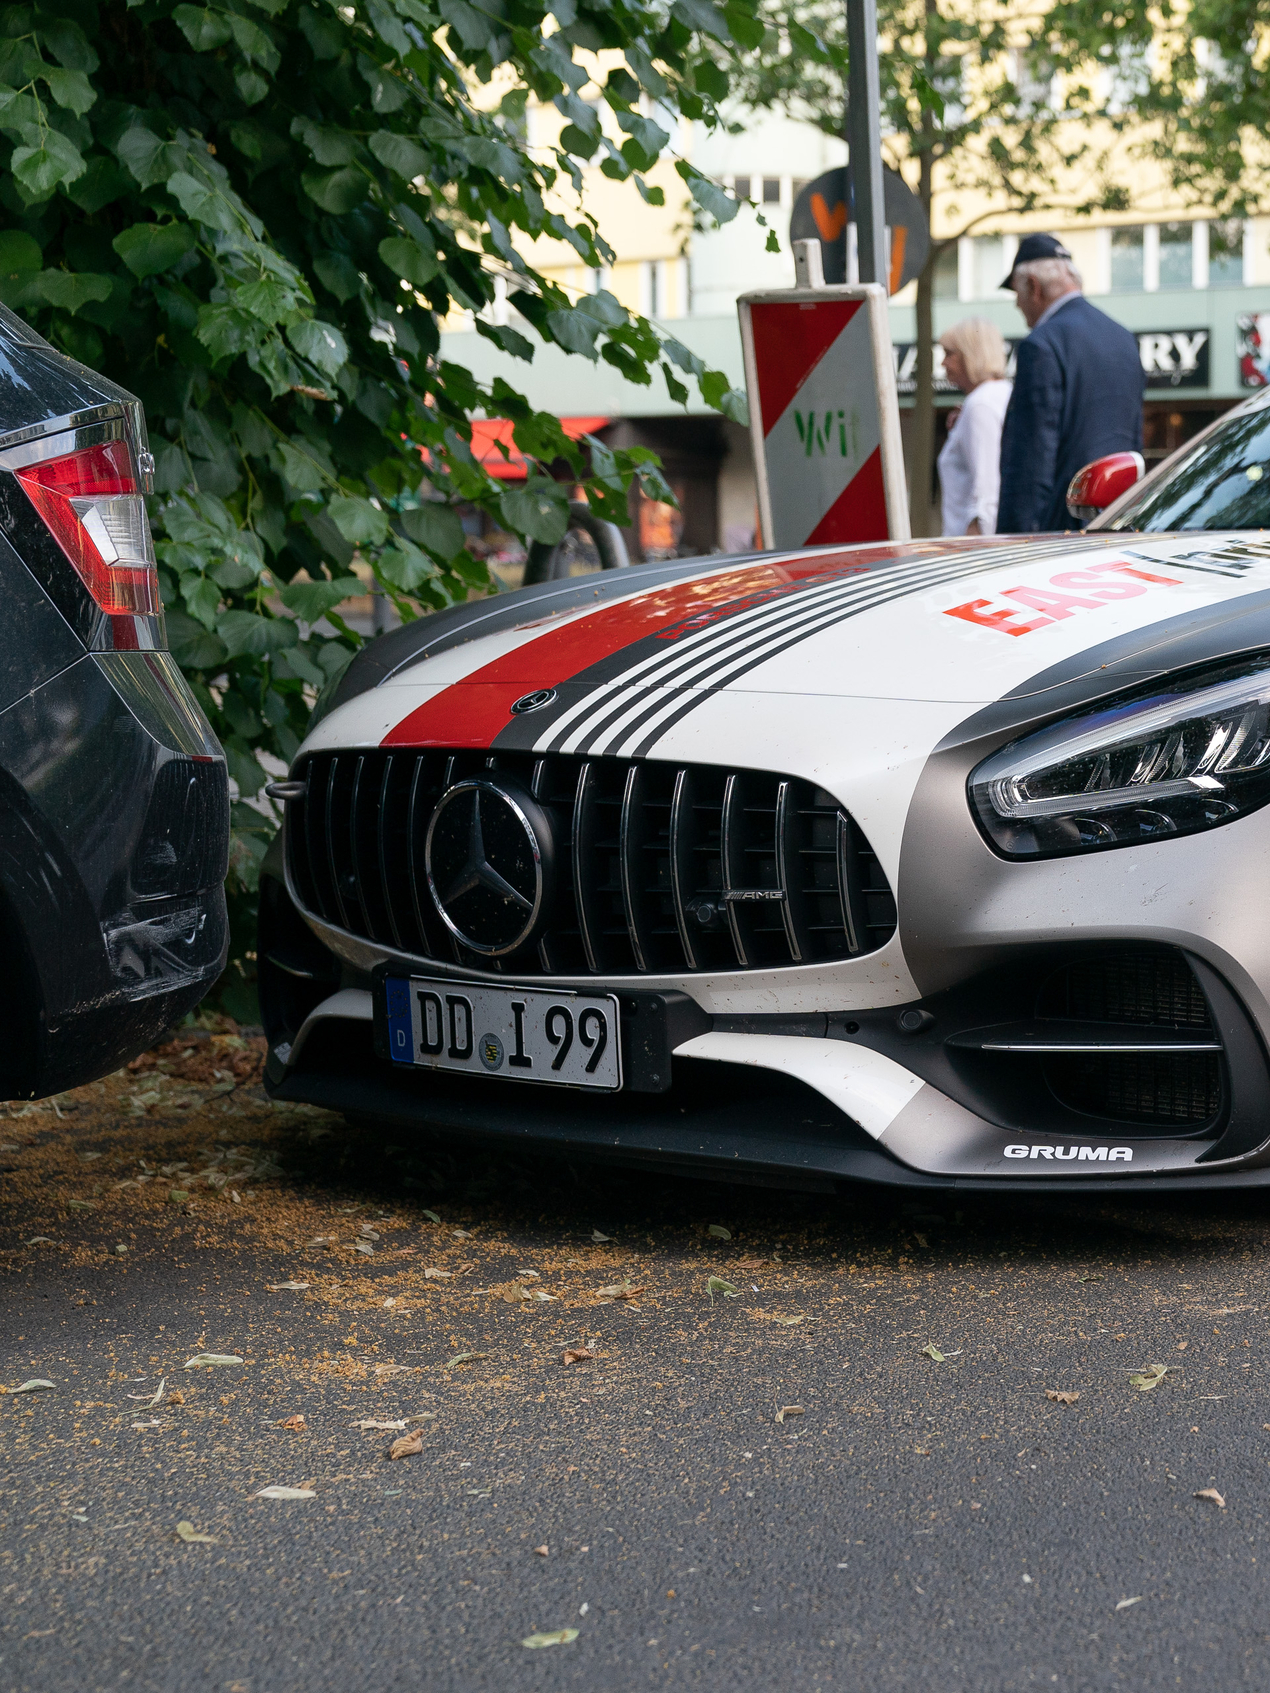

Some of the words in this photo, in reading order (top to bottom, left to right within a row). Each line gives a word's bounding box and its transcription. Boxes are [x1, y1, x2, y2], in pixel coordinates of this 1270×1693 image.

[941, 560, 1184, 637] EAST
[742, 891, 783, 900] AMG
[397, 1029, 407, 1048] D
[416, 989, 474, 1060] DD
[508, 1000, 533, 1068] I
[544, 1004, 608, 1073] 99
[1003, 1144, 1134, 1162] GRUMA
